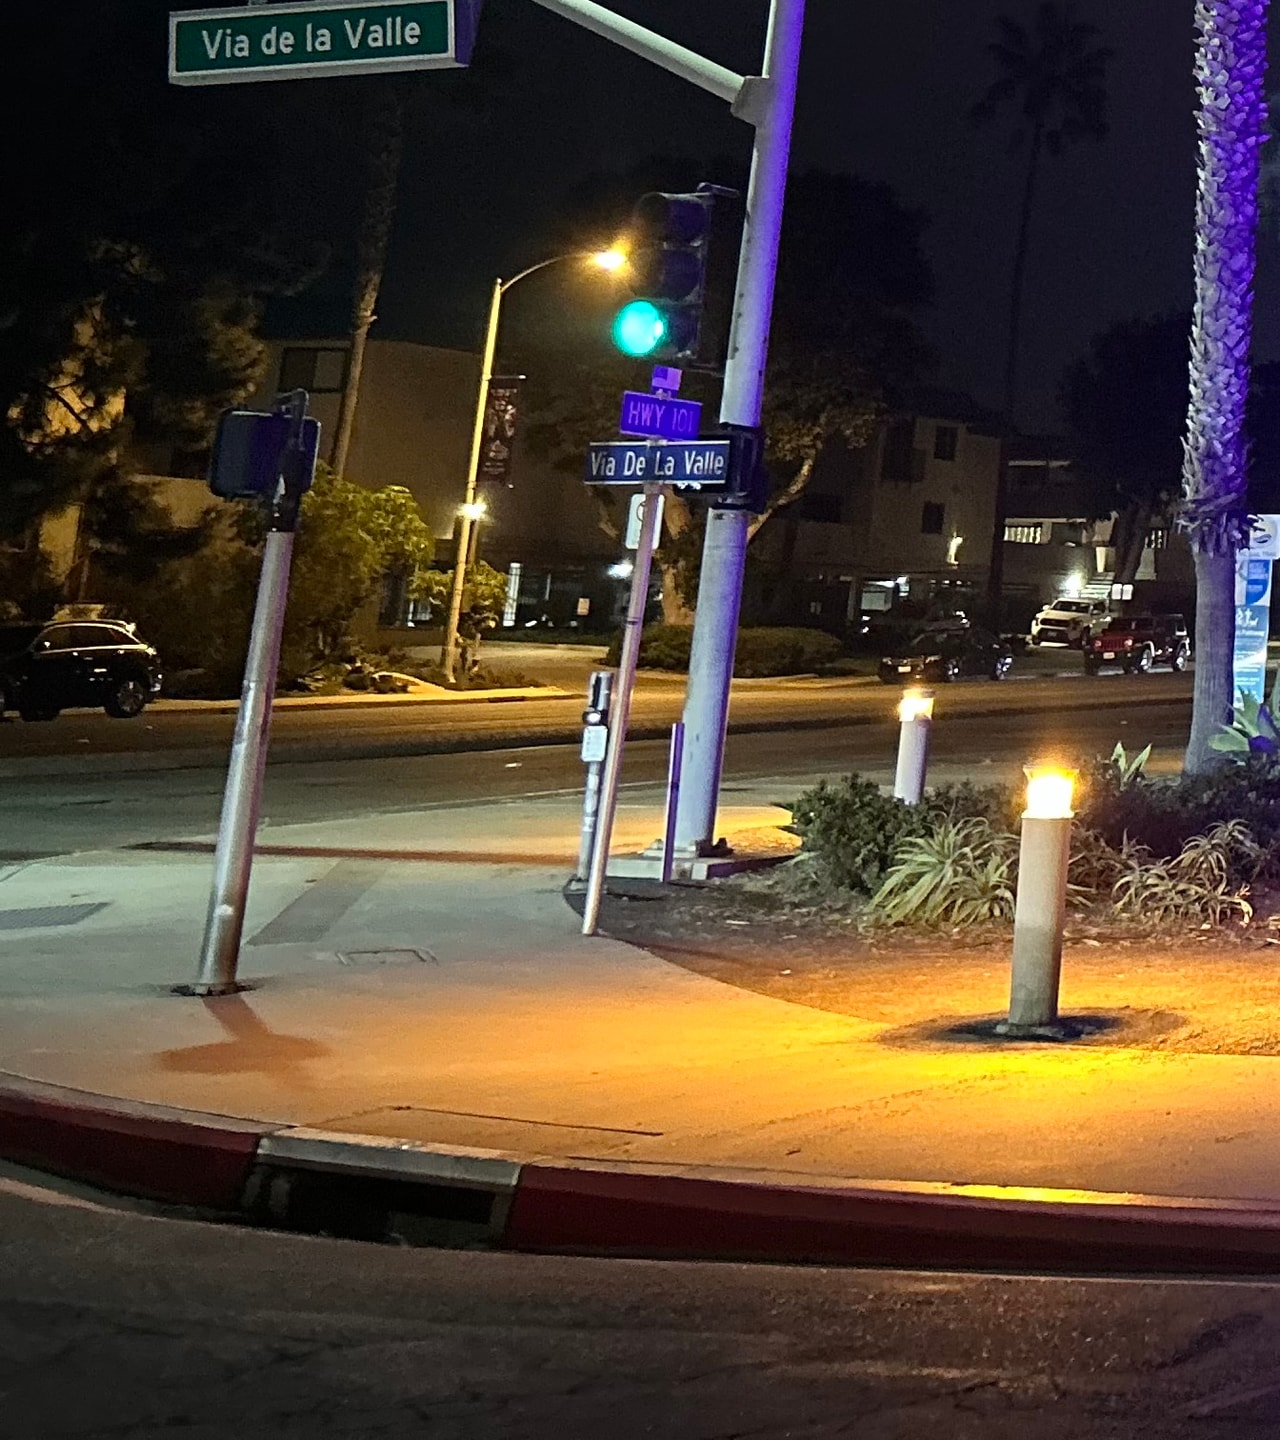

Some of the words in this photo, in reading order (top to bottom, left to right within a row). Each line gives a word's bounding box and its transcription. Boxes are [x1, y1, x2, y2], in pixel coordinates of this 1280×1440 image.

[202, 28, 249, 59] Via
[261, 26, 295, 55] de
[306, 23, 331, 52] la
[344, 16, 421, 49] Valle
[628, 401, 665, 429] HWY
[672, 407, 693, 432] 101
[591, 452, 616, 476] Via
[623, 451, 646, 476] De
[654, 450, 675, 476] La
[685, 450, 724, 475] Valle
